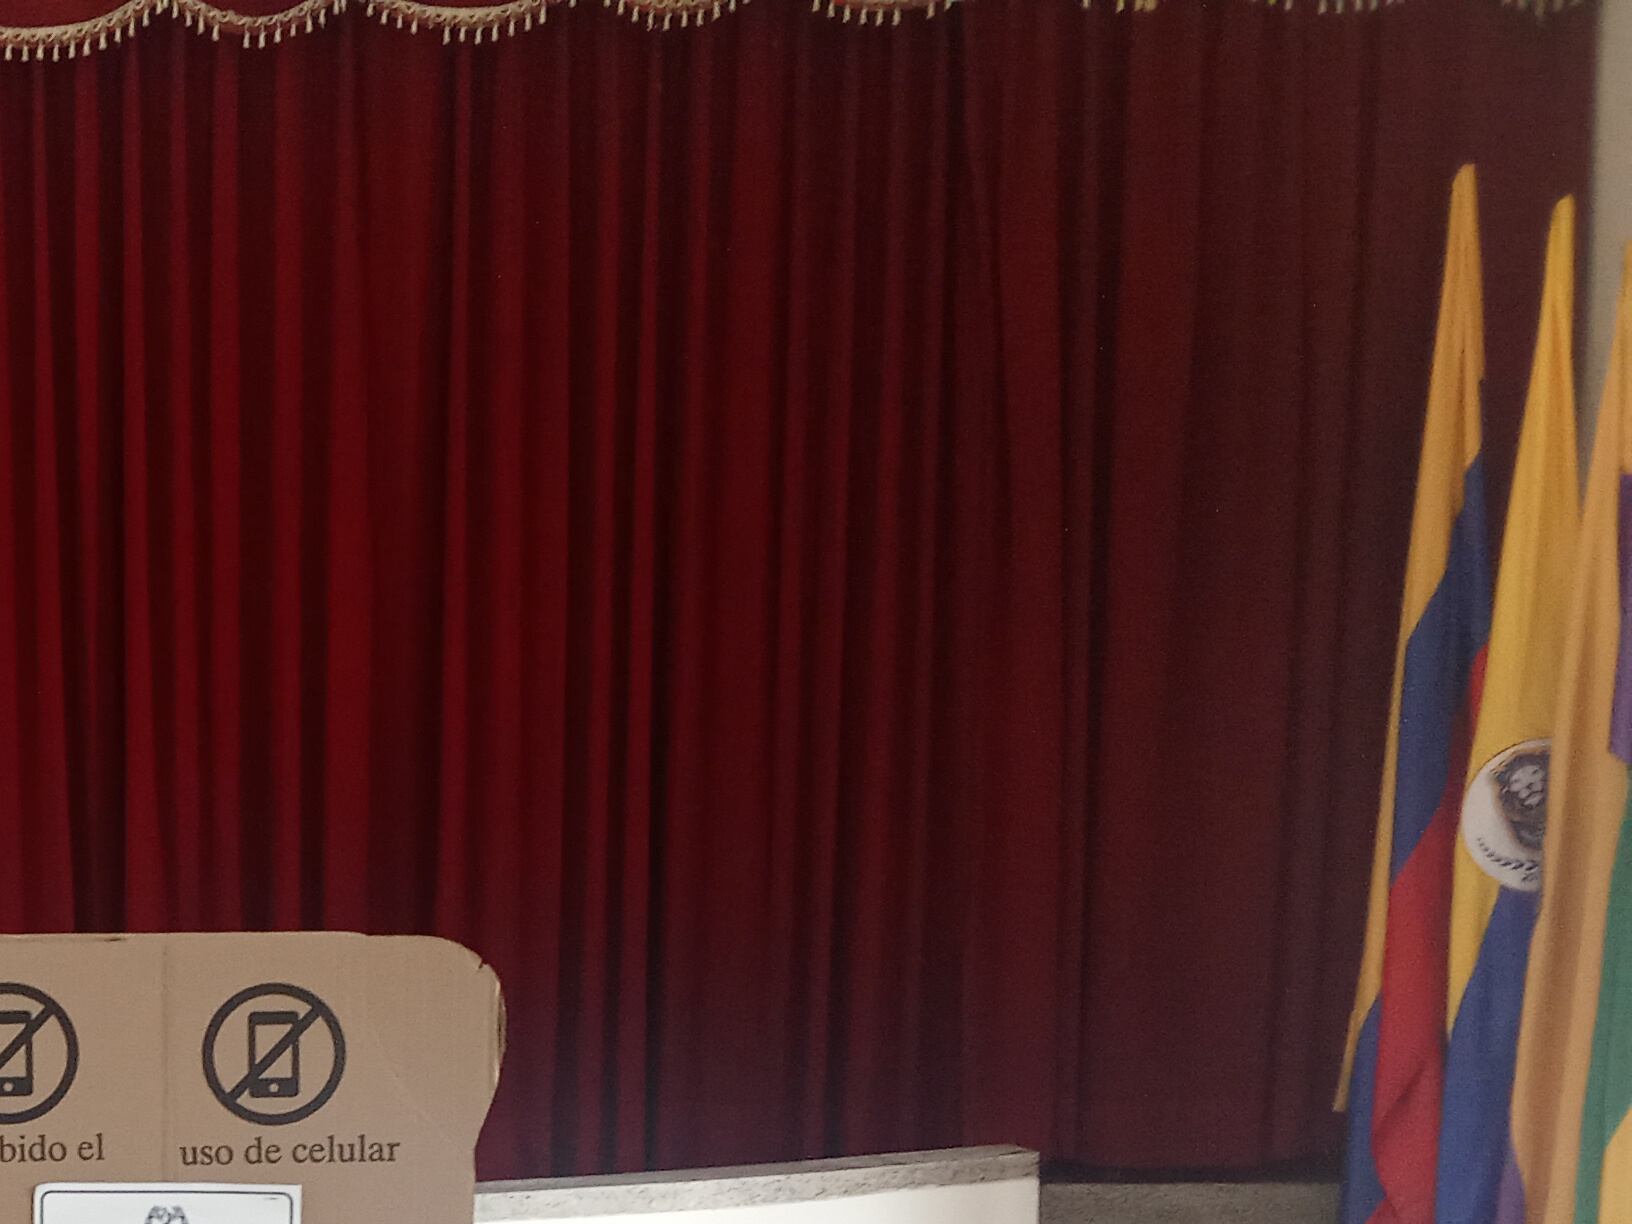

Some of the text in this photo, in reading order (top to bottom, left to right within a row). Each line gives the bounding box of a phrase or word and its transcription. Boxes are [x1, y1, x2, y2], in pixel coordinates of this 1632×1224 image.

[78, 1132, 106, 1161] el
[179, 1144, 234, 1166] uso
[244, 1136, 282, 1164] de
[292, 1134, 401, 1163] celular
